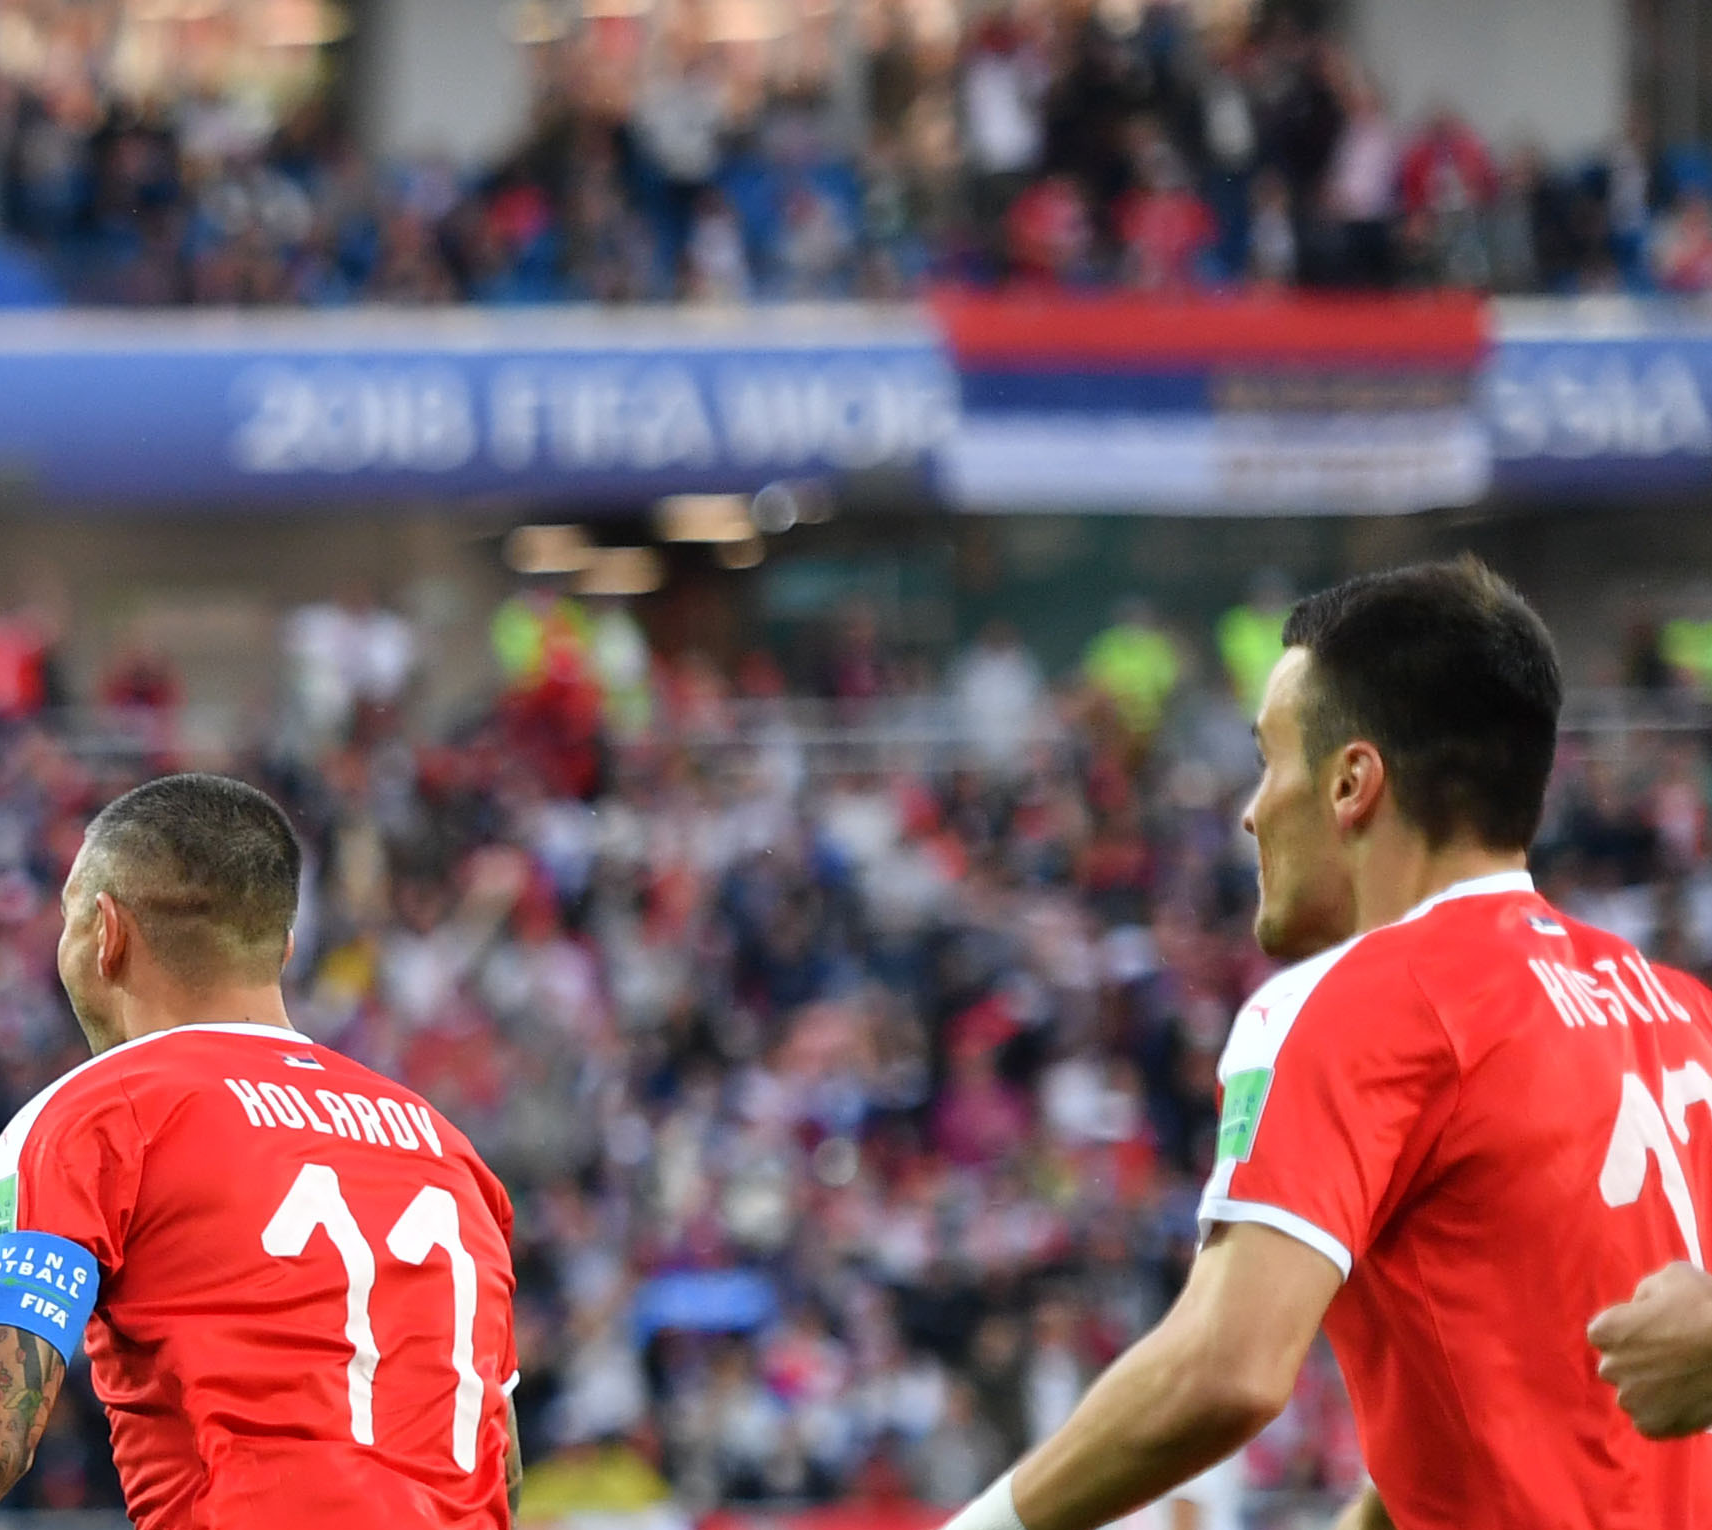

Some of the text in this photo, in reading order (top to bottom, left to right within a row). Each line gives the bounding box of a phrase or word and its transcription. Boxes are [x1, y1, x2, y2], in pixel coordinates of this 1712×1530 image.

[223, 1077, 446, 1158] KOLAROV
[20, 1292, 69, 1329] FIFA
[260, 1162, 485, 1475] 11
